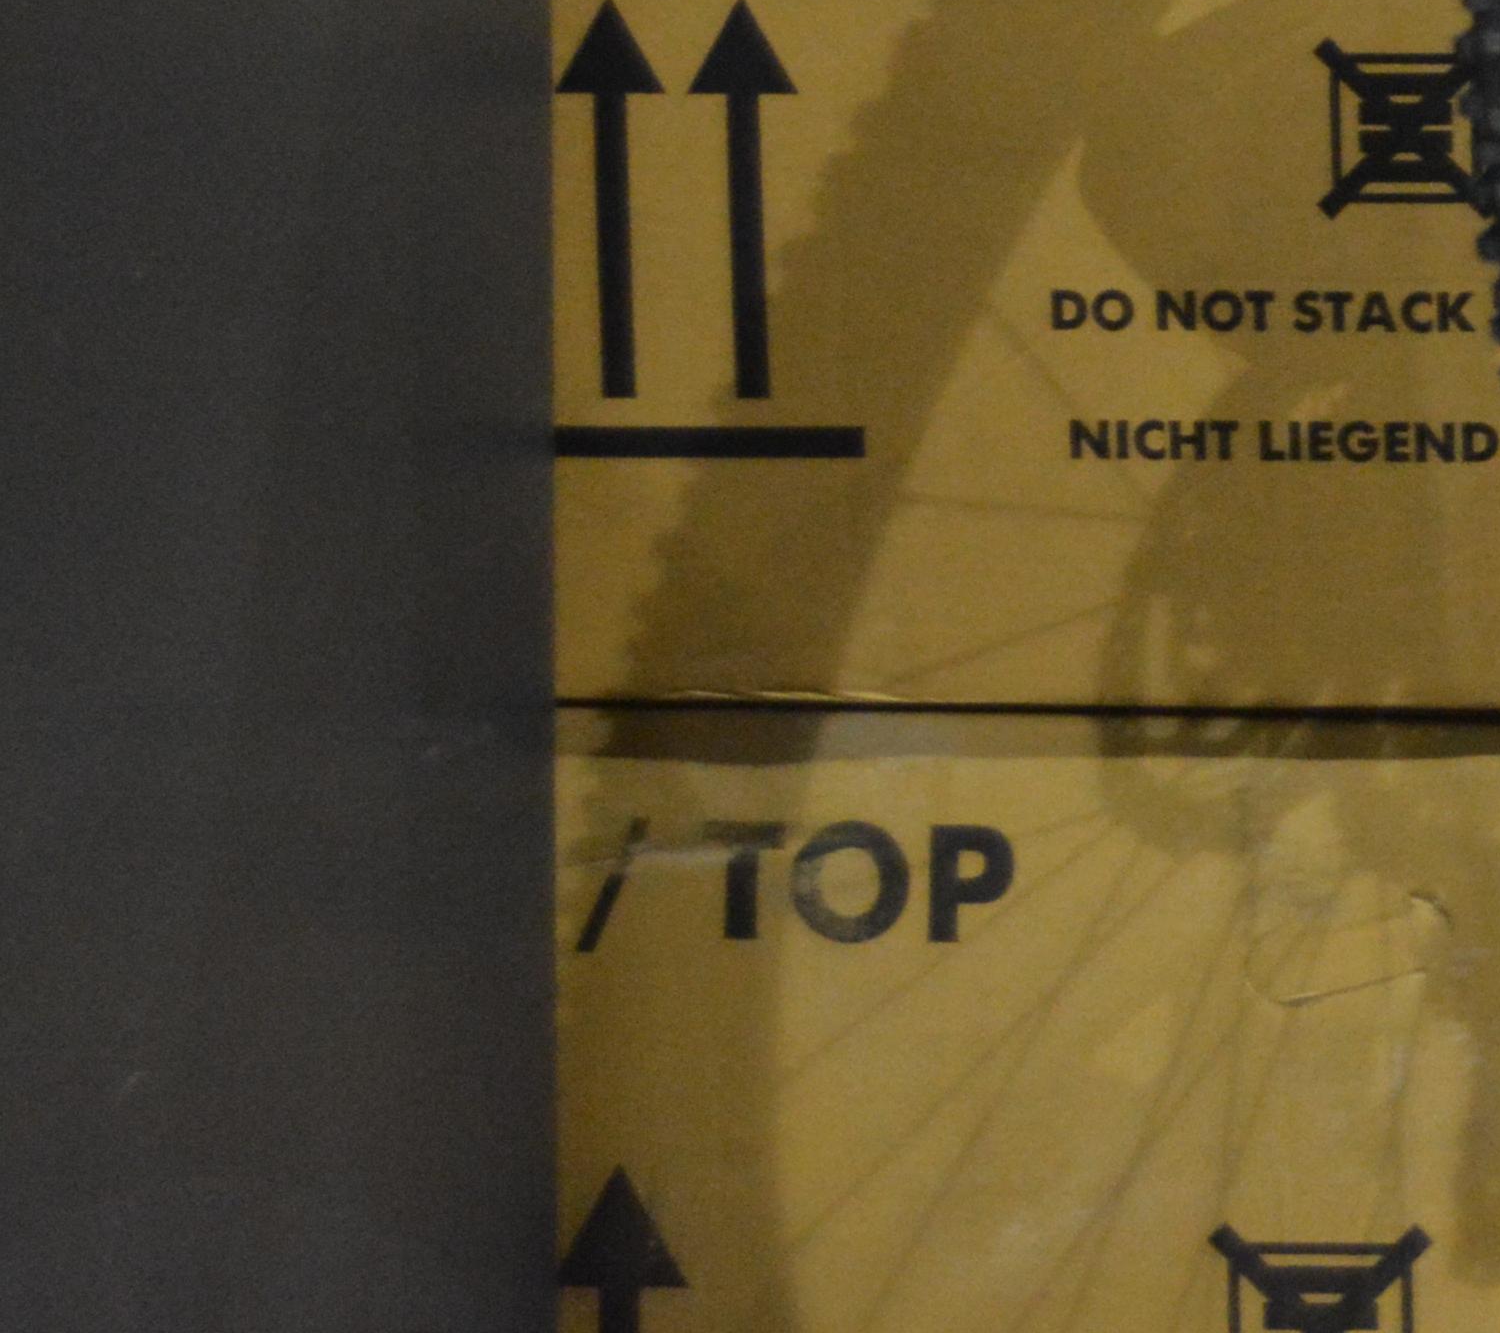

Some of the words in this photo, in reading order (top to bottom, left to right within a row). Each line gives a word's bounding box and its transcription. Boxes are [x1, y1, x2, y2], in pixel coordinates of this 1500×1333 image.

[1052, 289, 1134, 332] DO
[1156, 289, 1276, 333] NOT
[1292, 289, 1475, 334] STACK
[1069, 419, 1241, 462] NICHT
[1258, 419, 1500, 464] LIEGEND
[705, 820, 1015, 946] TOP
